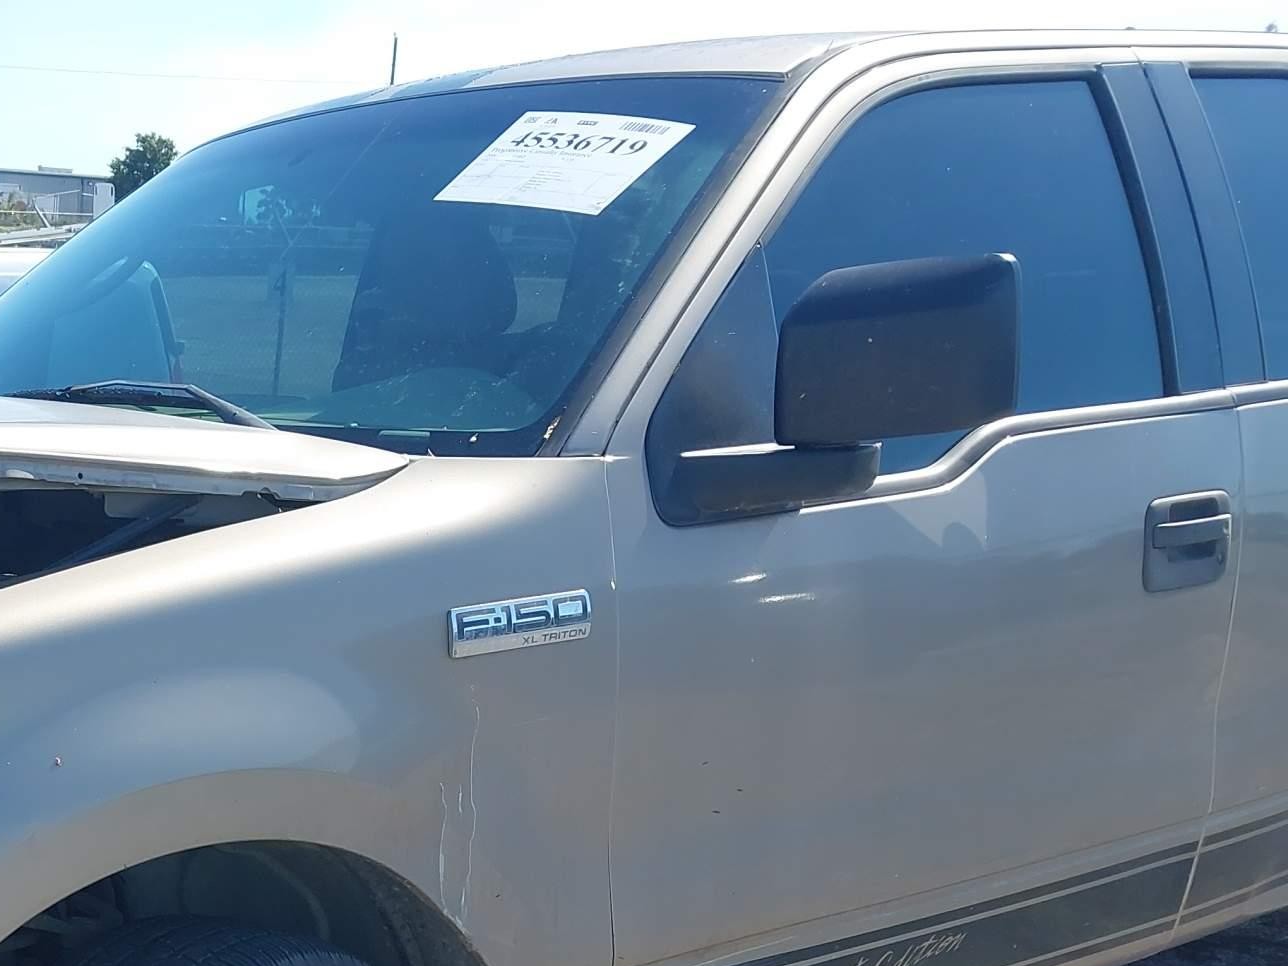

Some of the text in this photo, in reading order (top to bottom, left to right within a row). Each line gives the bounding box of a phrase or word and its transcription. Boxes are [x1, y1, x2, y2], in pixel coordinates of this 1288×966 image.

[511, 130, 648, 156] 45536719
[522, 628, 587, 645] XL TRITON
